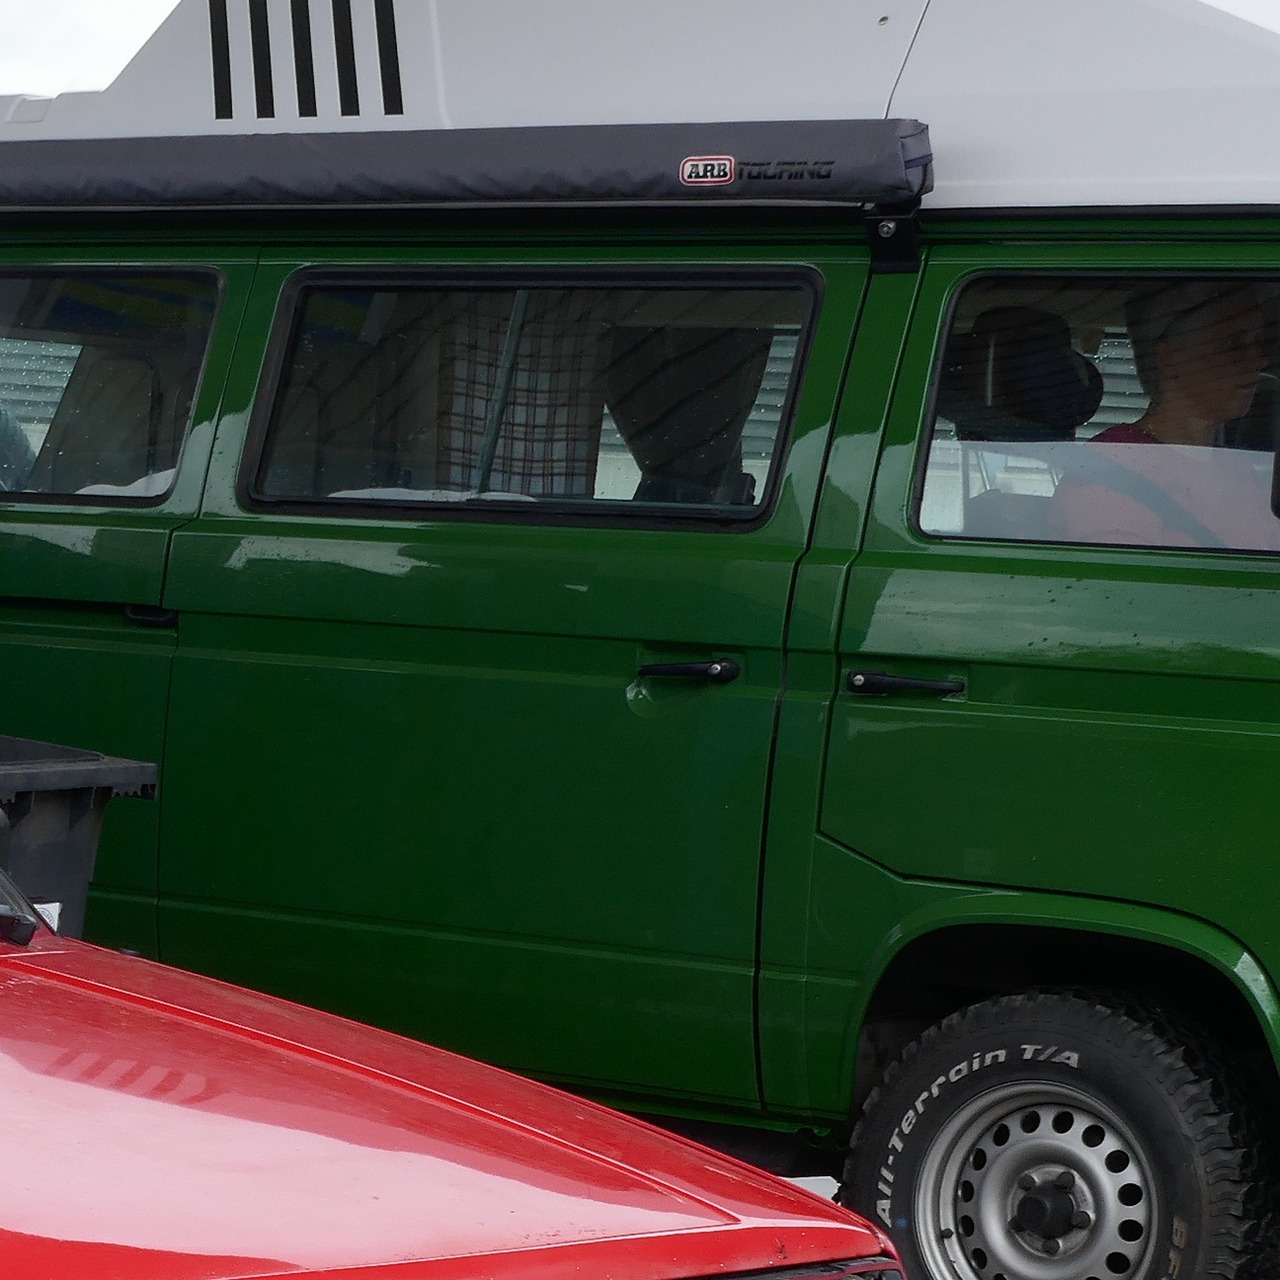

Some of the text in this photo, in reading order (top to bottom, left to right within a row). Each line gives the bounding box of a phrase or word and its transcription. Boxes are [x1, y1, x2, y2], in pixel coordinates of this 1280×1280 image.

[686, 162, 729, 180] ARB
[876, 1043, 1081, 1228] All-Terrain T/A
